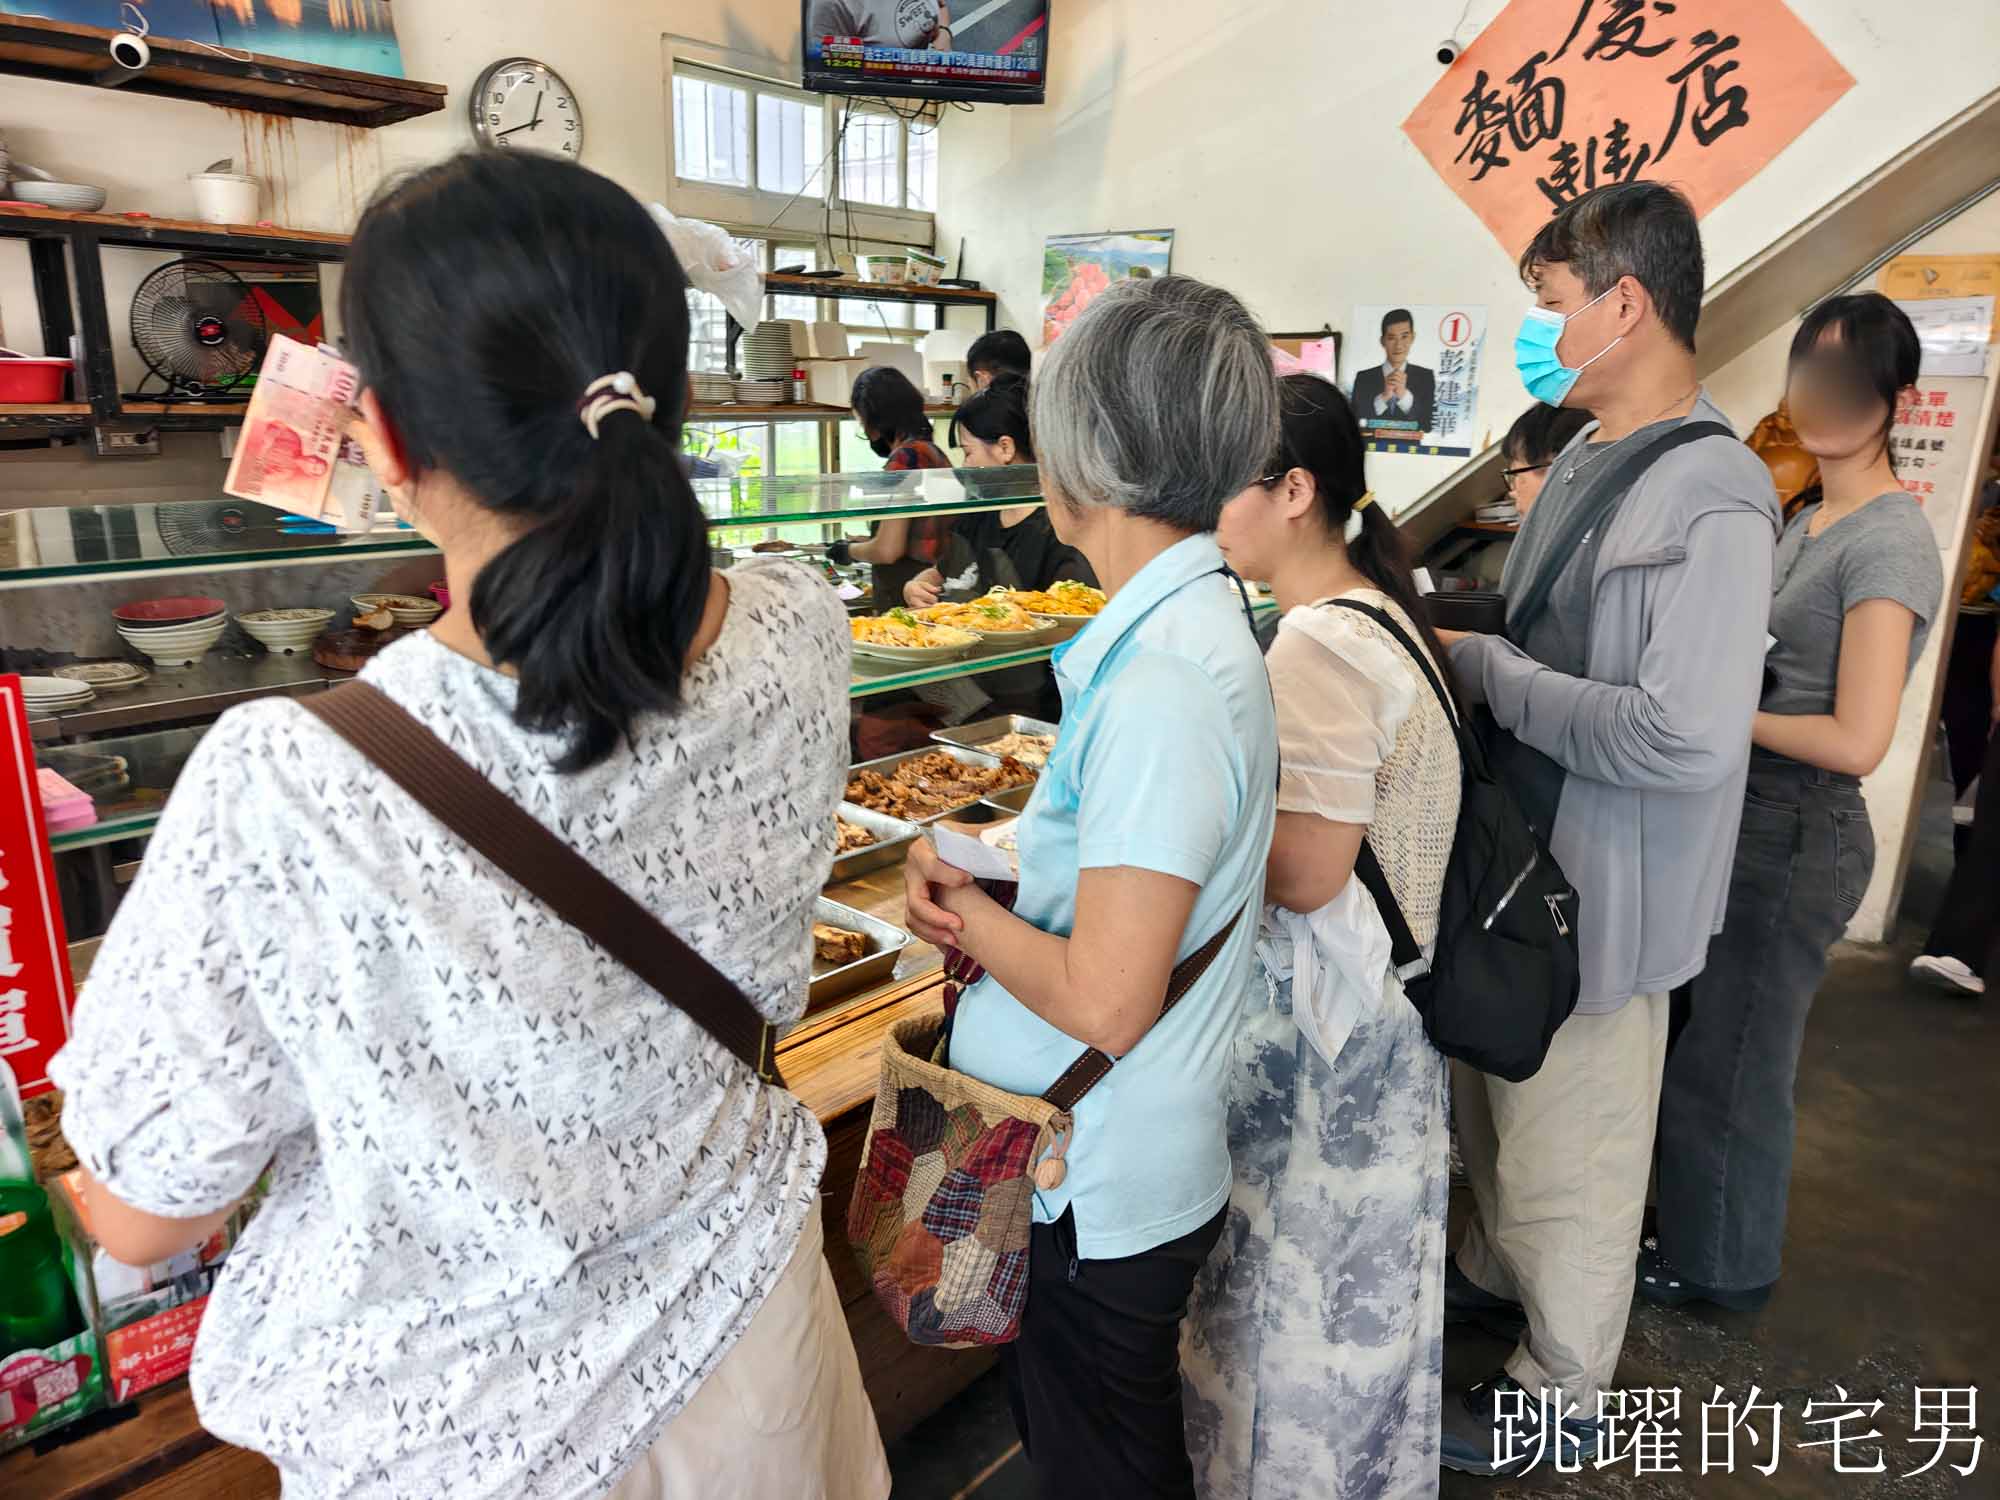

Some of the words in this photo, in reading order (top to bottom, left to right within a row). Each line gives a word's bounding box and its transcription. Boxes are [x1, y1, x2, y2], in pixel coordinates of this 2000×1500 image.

[556, 97, 568, 109] 2
[1649, 30, 1750, 166] 店
[564, 119, 576, 132] 3
